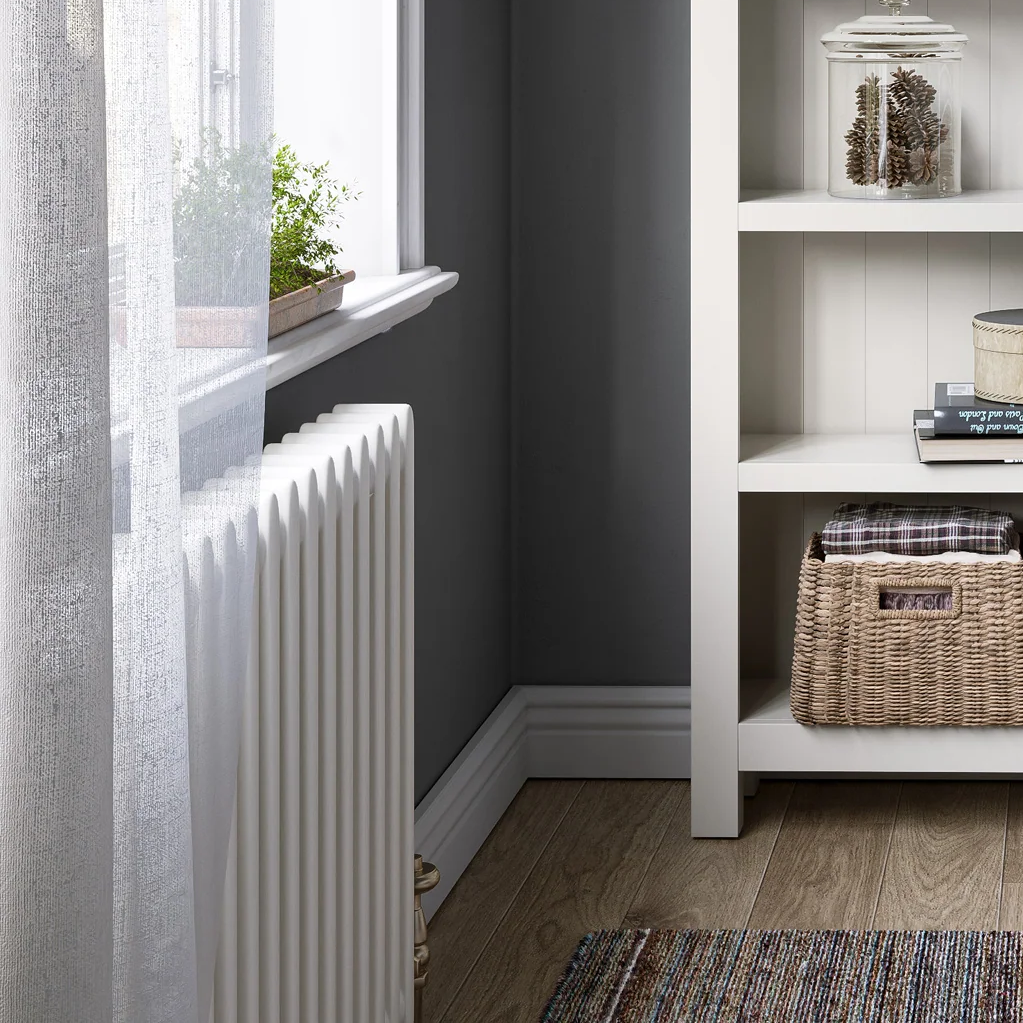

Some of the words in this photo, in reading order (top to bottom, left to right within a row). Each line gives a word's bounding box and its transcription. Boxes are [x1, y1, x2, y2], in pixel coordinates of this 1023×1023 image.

[958, 411, 987, 422] London
[988, 410, 1004, 422] and
[970, 423, 984, 434] Out
[986, 423, 1002, 434] and
